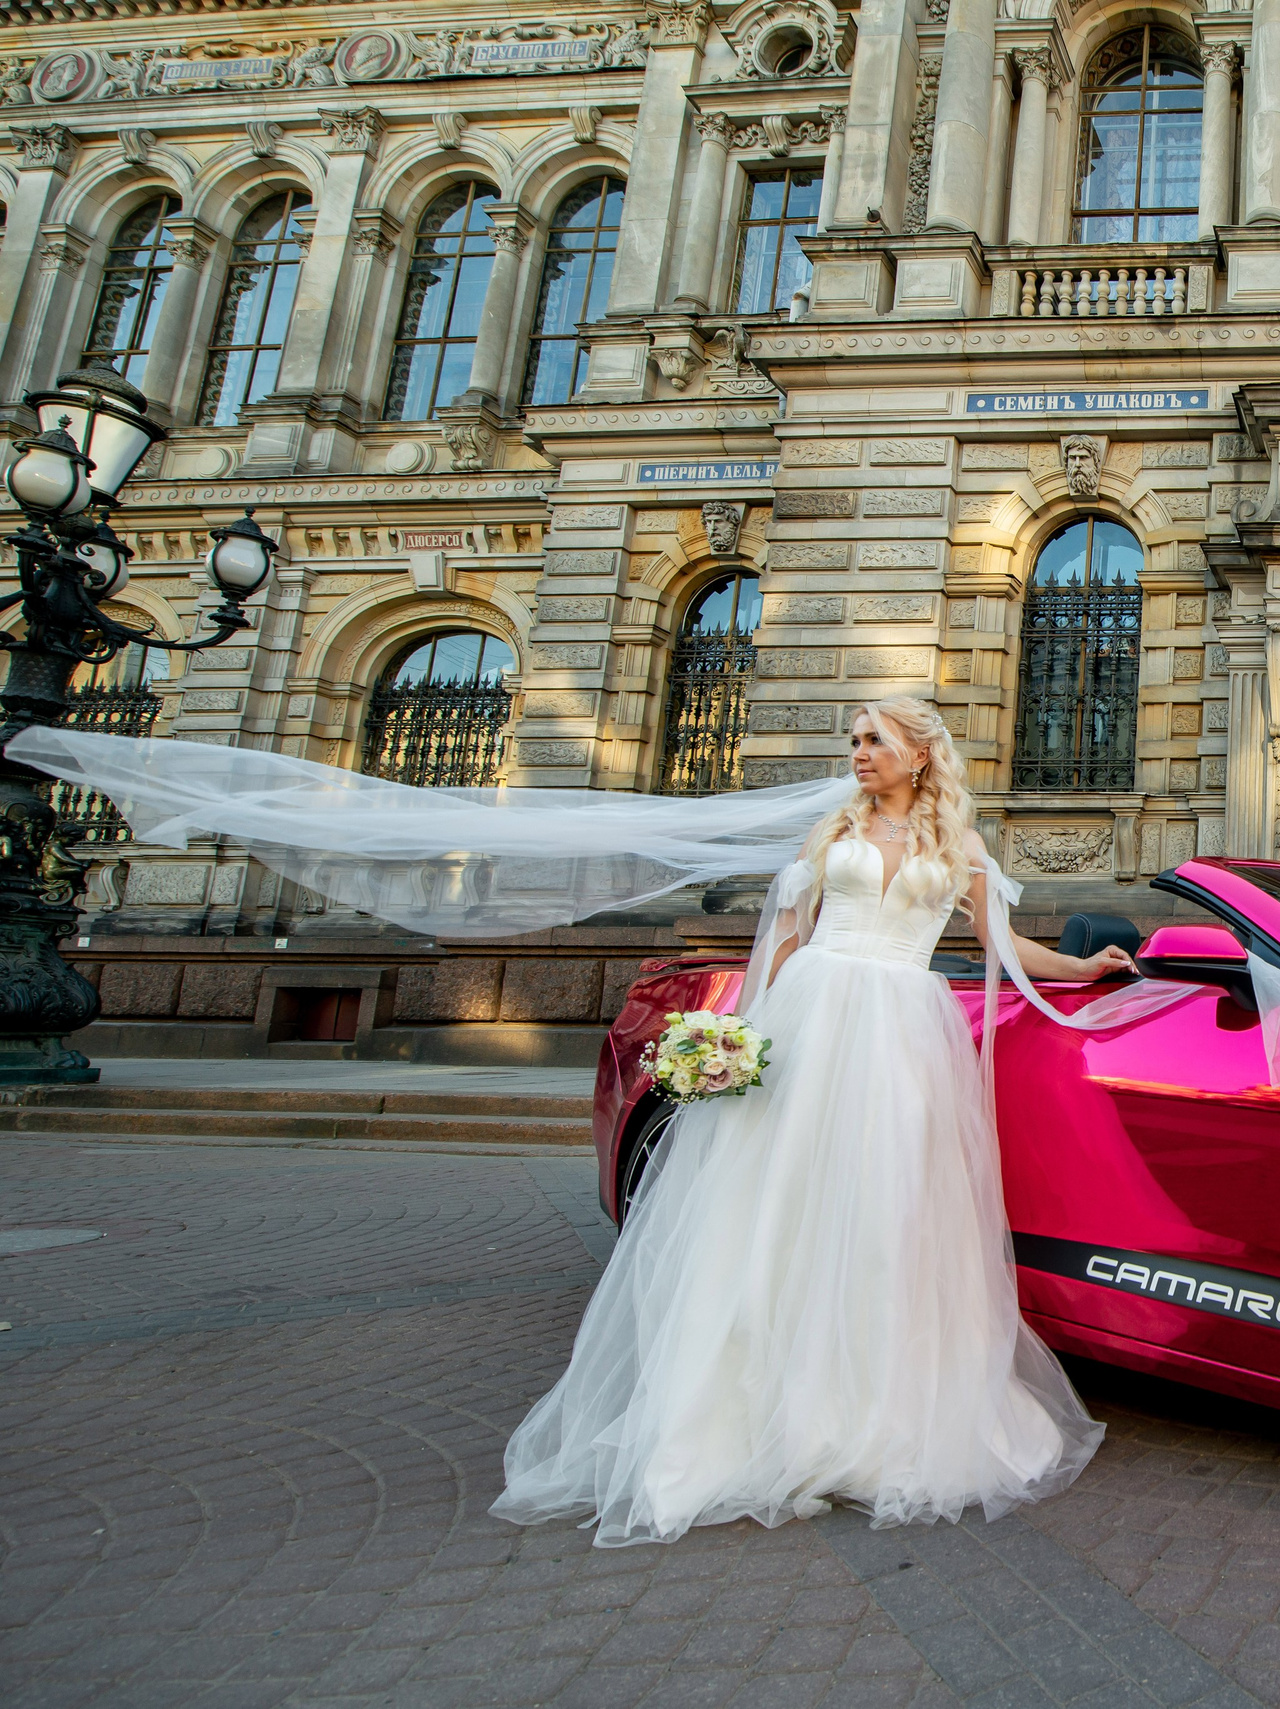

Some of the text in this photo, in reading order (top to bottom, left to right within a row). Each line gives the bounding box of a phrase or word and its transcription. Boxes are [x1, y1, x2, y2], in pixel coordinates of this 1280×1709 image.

[993, 393, 1182, 411] СЕМЕНЪ УШАКОВЪ
[722, 464, 761, 479] ДЕЛЬ
[407, 534, 460, 548] ДЮСЕРСО
